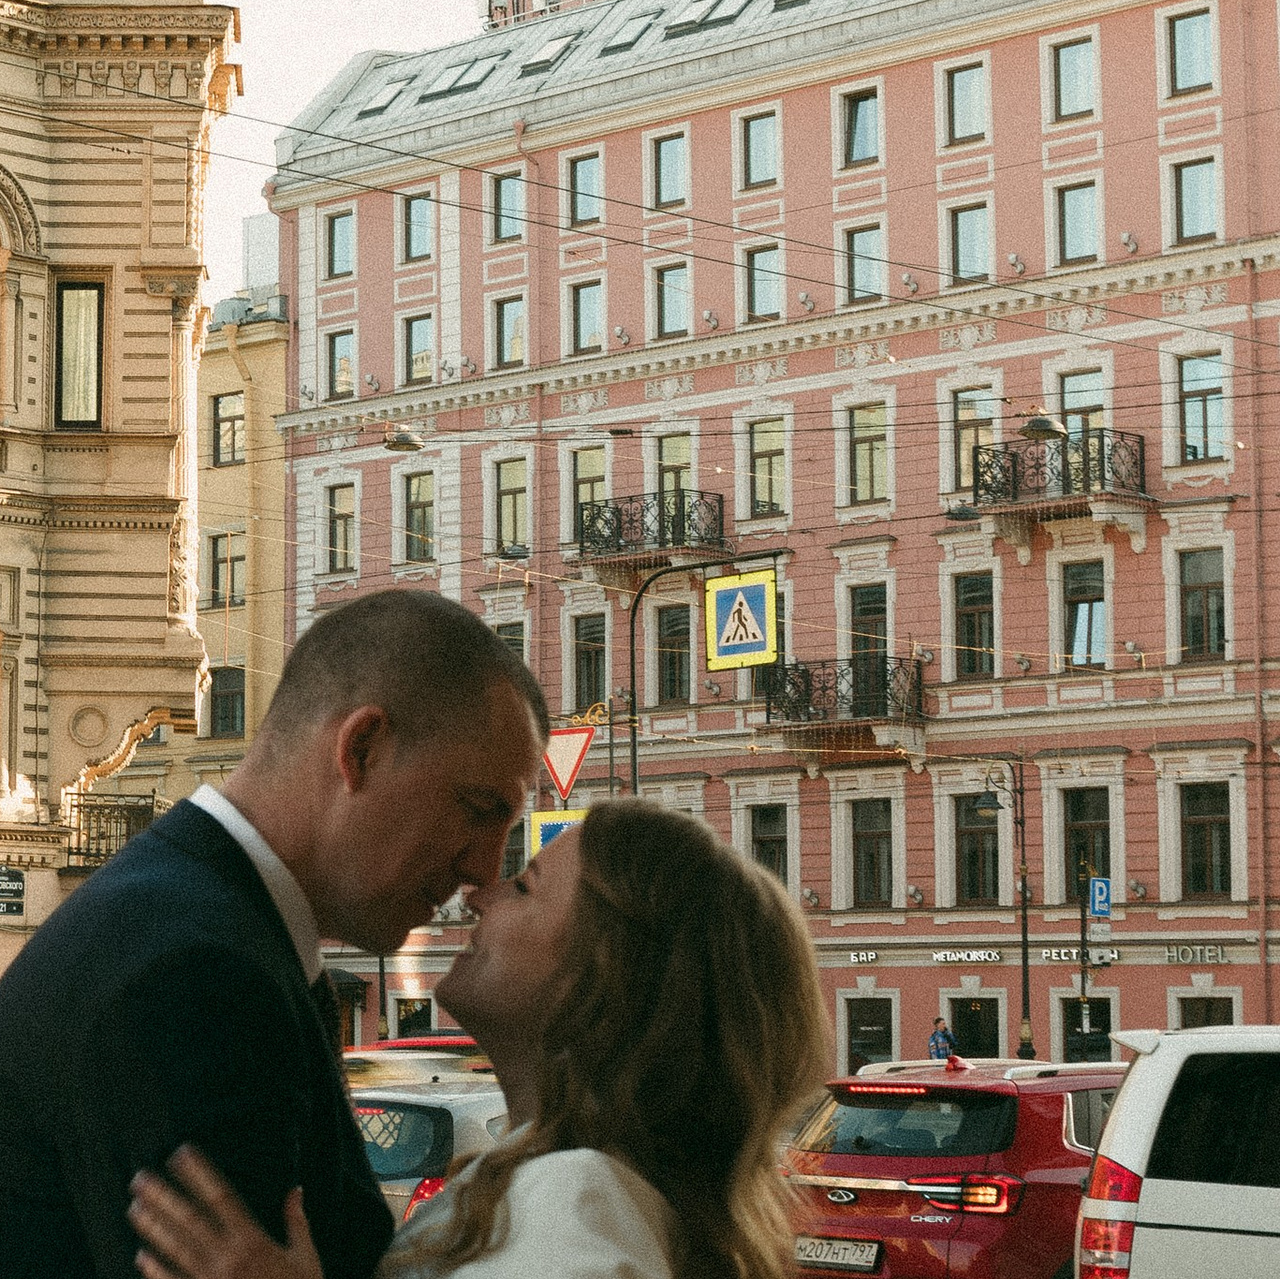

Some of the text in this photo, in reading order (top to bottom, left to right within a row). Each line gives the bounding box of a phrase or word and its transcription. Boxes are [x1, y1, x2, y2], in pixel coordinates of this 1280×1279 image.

[0, 903, 7, 912] 21
[850, 952, 876, 963] БАР
[933, 951, 1000, 962] METAMORFOS
[1042, 950, 1119, 960] РЕСТН
[1165, 945, 1231, 963] HOTEL
[910, 1215, 953, 1223] CHERY
